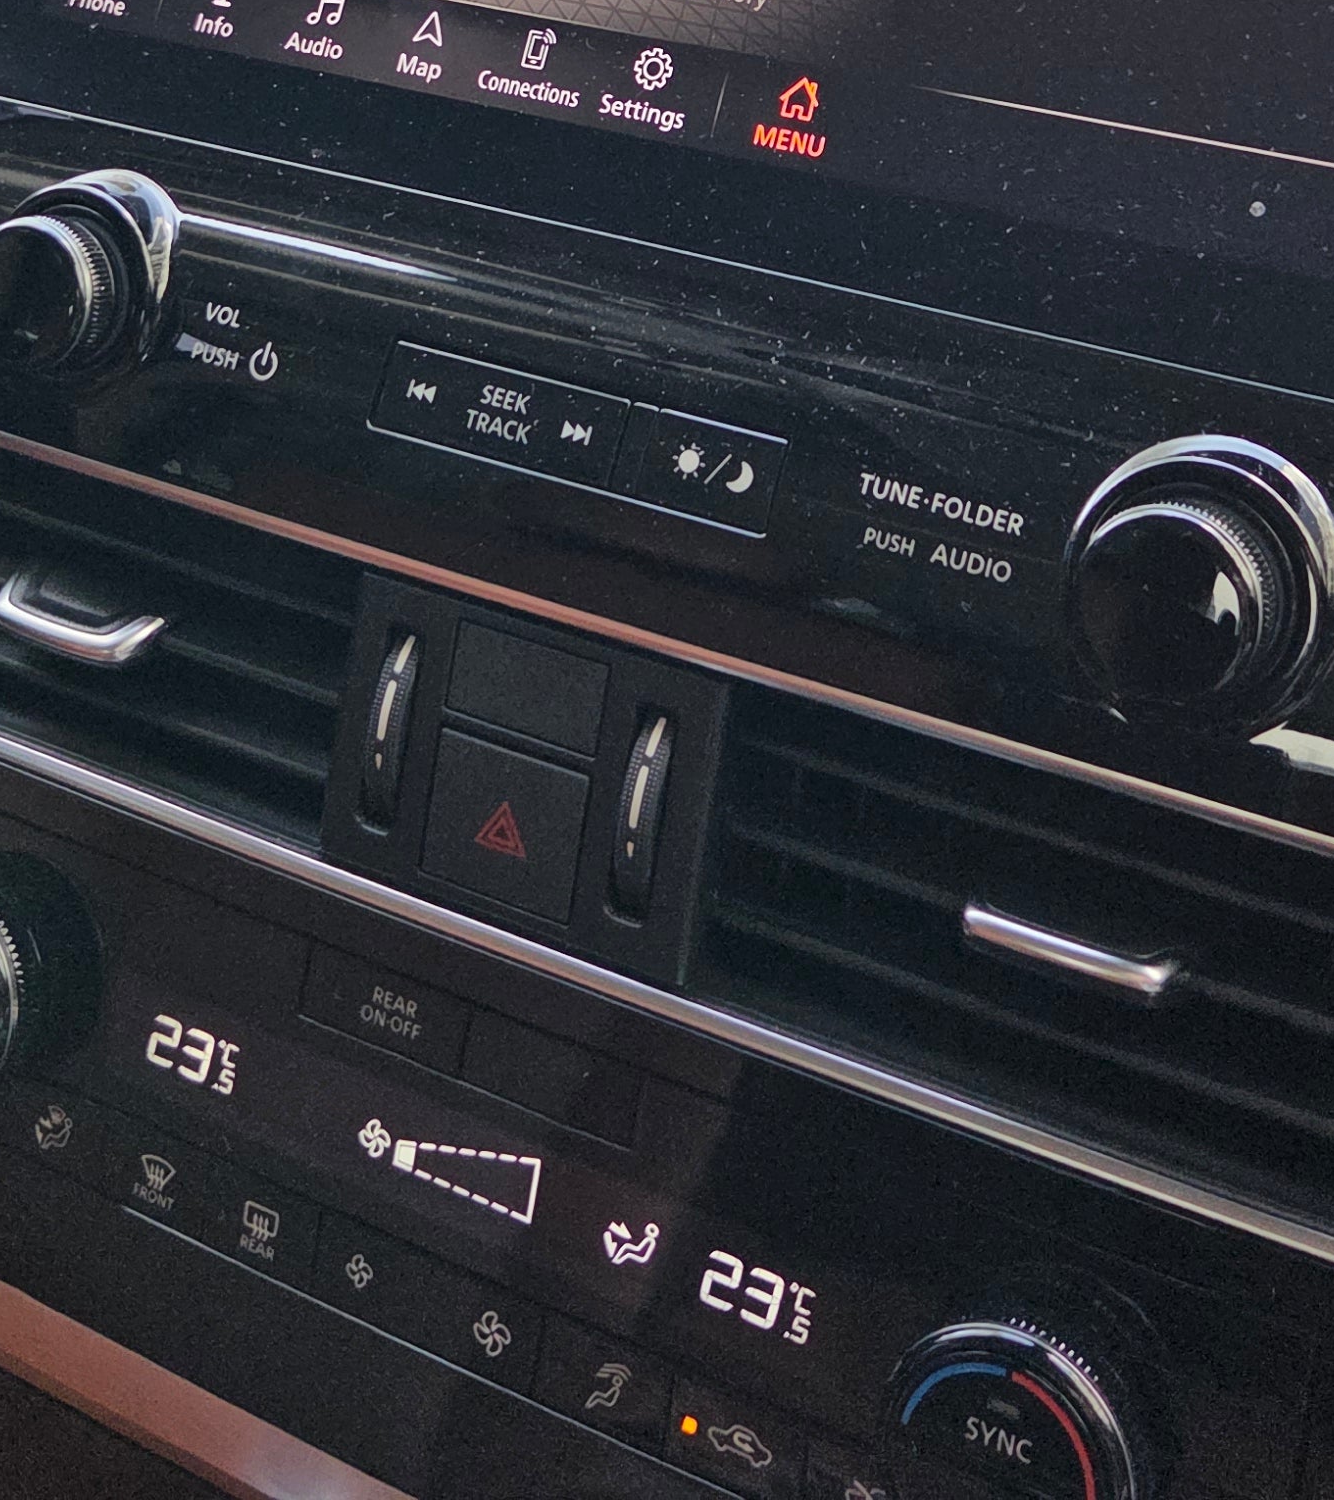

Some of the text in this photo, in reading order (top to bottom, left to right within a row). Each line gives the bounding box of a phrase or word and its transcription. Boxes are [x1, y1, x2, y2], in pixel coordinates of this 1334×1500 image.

[193, 11, 235, 40] Info
[284, 31, 344, 62] Audio
[396, 51, 443, 85] Map
[477, 68, 581, 108] Connections
[598, 93, 686, 133] Settings
[752, 123, 827, 159] MENU
[205, 300, 242, 330] VOL
[190, 338, 241, 371] PUSH
[480, 383, 532, 416] SEEK
[465, 408, 534, 445] TRACK
[863, 525, 1013, 584] PUSH AUDIO
[371, 985, 419, 1019] REAR
[132, 1181, 174, 1211] FRONT
[240, 1233, 275, 1262] REAR
[965, 1415, 1033, 1464] SYNC
